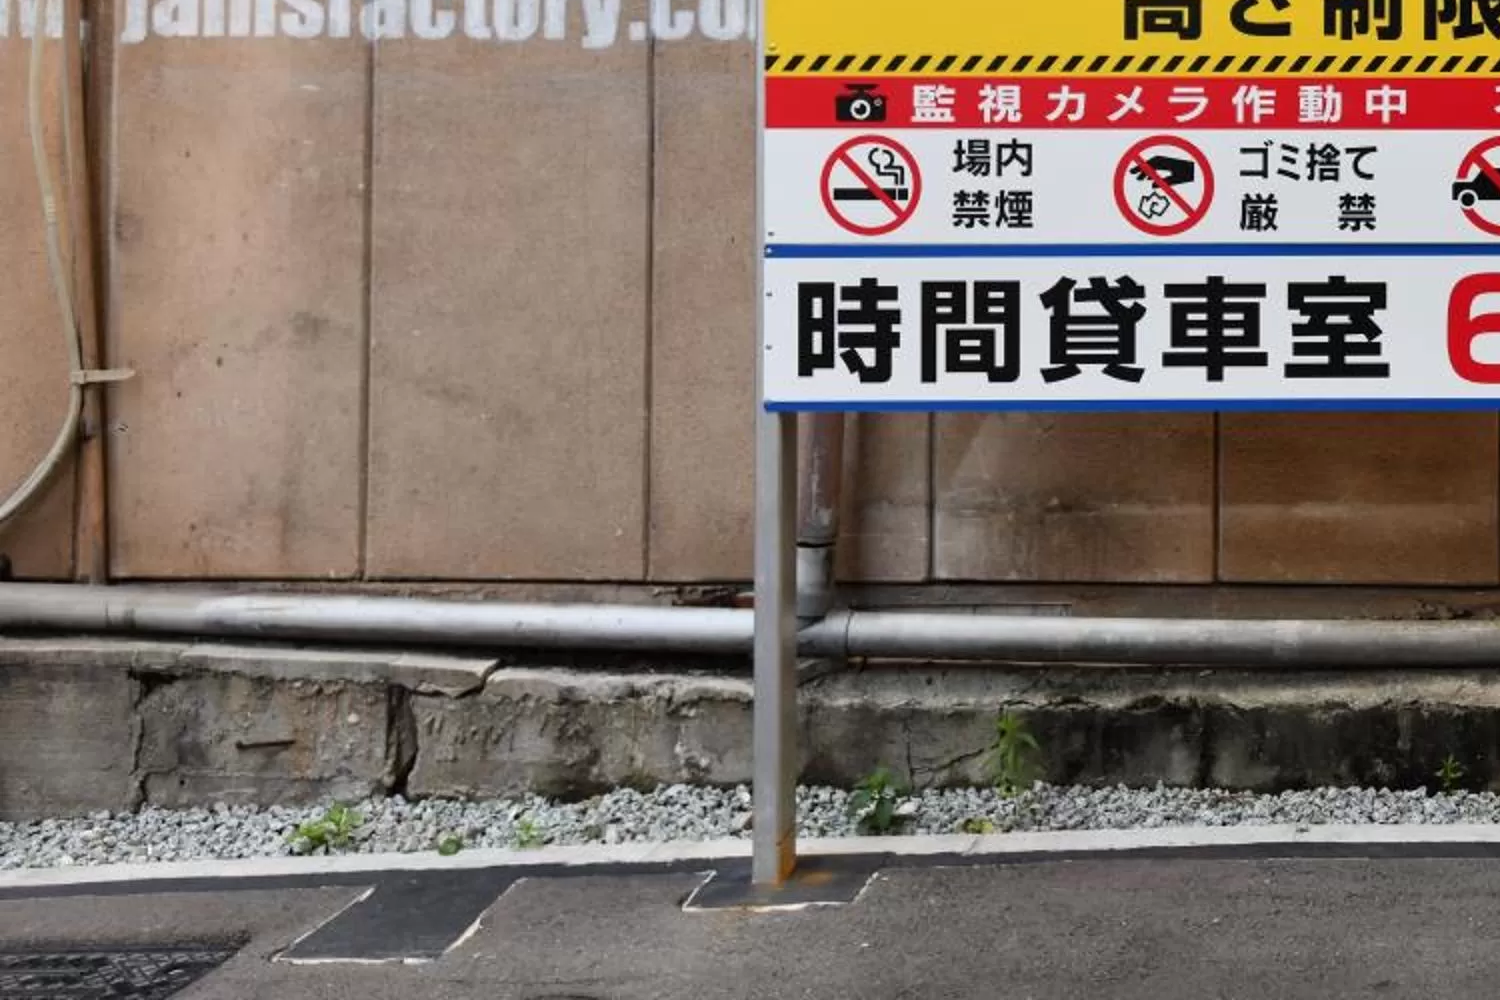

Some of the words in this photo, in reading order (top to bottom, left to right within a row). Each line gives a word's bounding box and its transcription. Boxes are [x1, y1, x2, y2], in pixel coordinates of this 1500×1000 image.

[911, 84, 1406, 123] 監視カメラ作動中
[953, 138, 1032, 176] 場内
[1240, 140, 1377, 182] ゴミ捨て
[953, 190, 1033, 228] 禁煙
